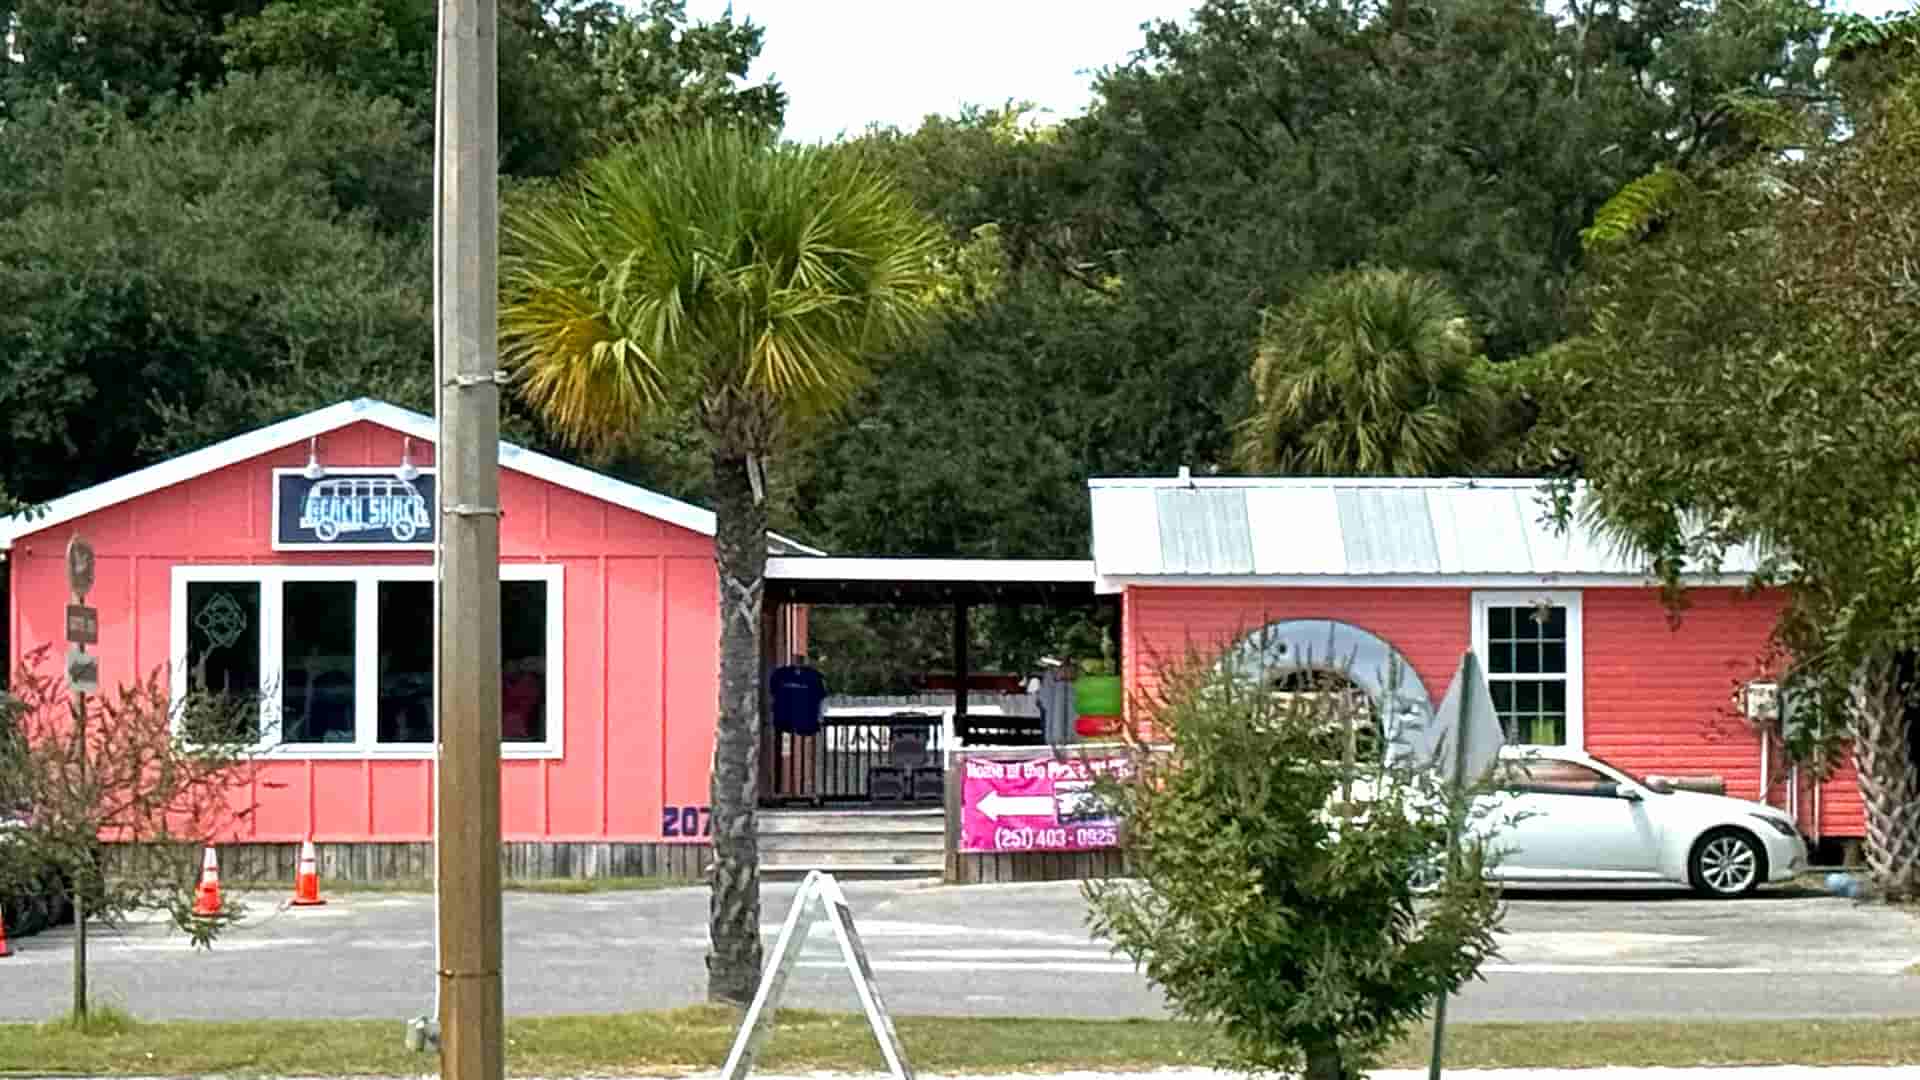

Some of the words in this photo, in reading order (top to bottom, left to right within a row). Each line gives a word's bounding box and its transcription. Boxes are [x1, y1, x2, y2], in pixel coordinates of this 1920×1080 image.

[369, 496, 429, 526] SHACK
[663, 807, 711, 836] 207
[994, 826, 1034, 849] (251)
